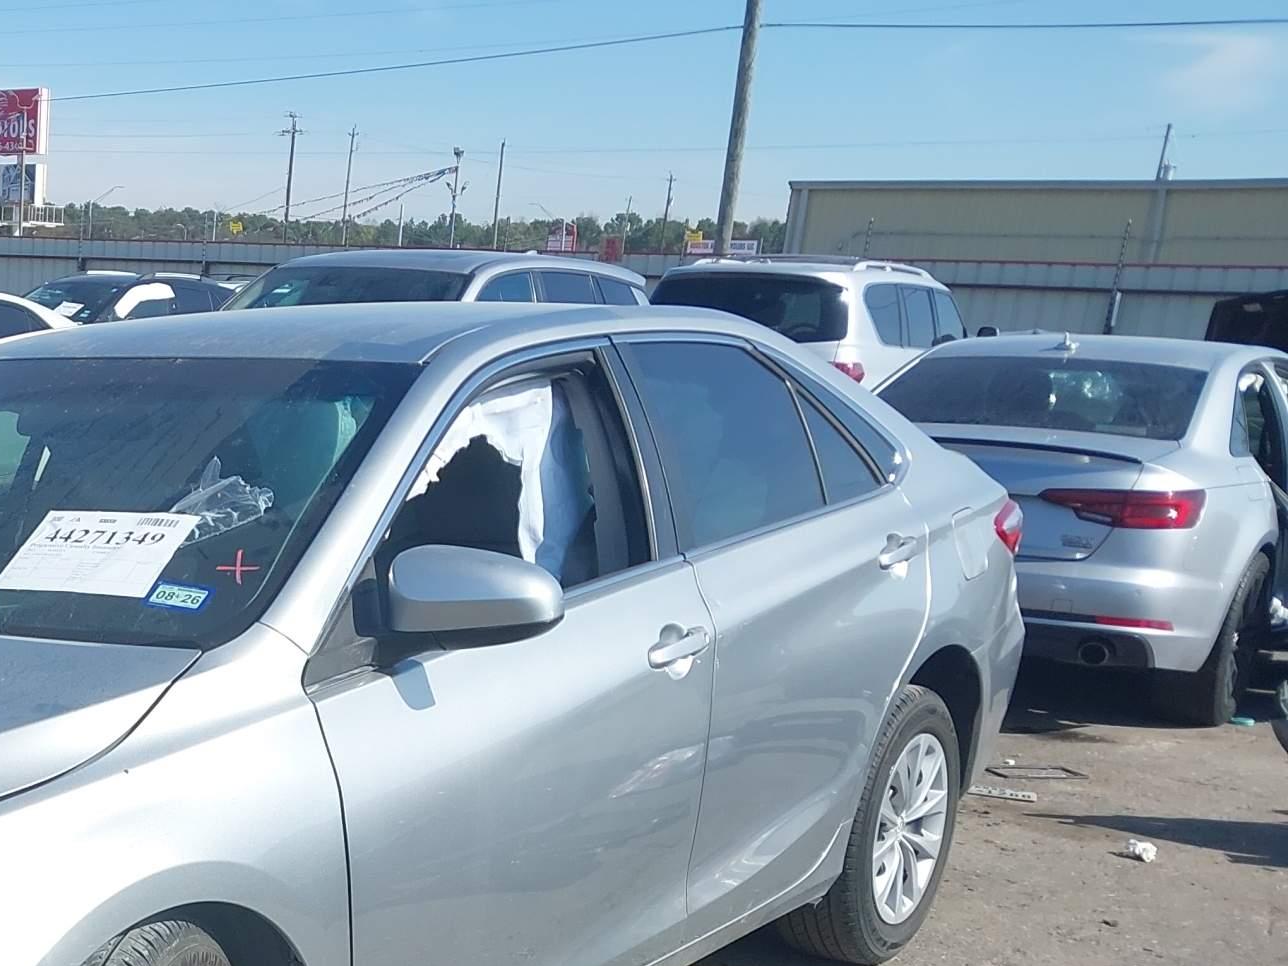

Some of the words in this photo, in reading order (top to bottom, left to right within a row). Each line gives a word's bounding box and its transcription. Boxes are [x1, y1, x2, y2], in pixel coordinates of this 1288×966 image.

[45, 528, 166, 546] 44271349
[155, 590, 176, 601] 08
[179, 593, 202, 605] 26
